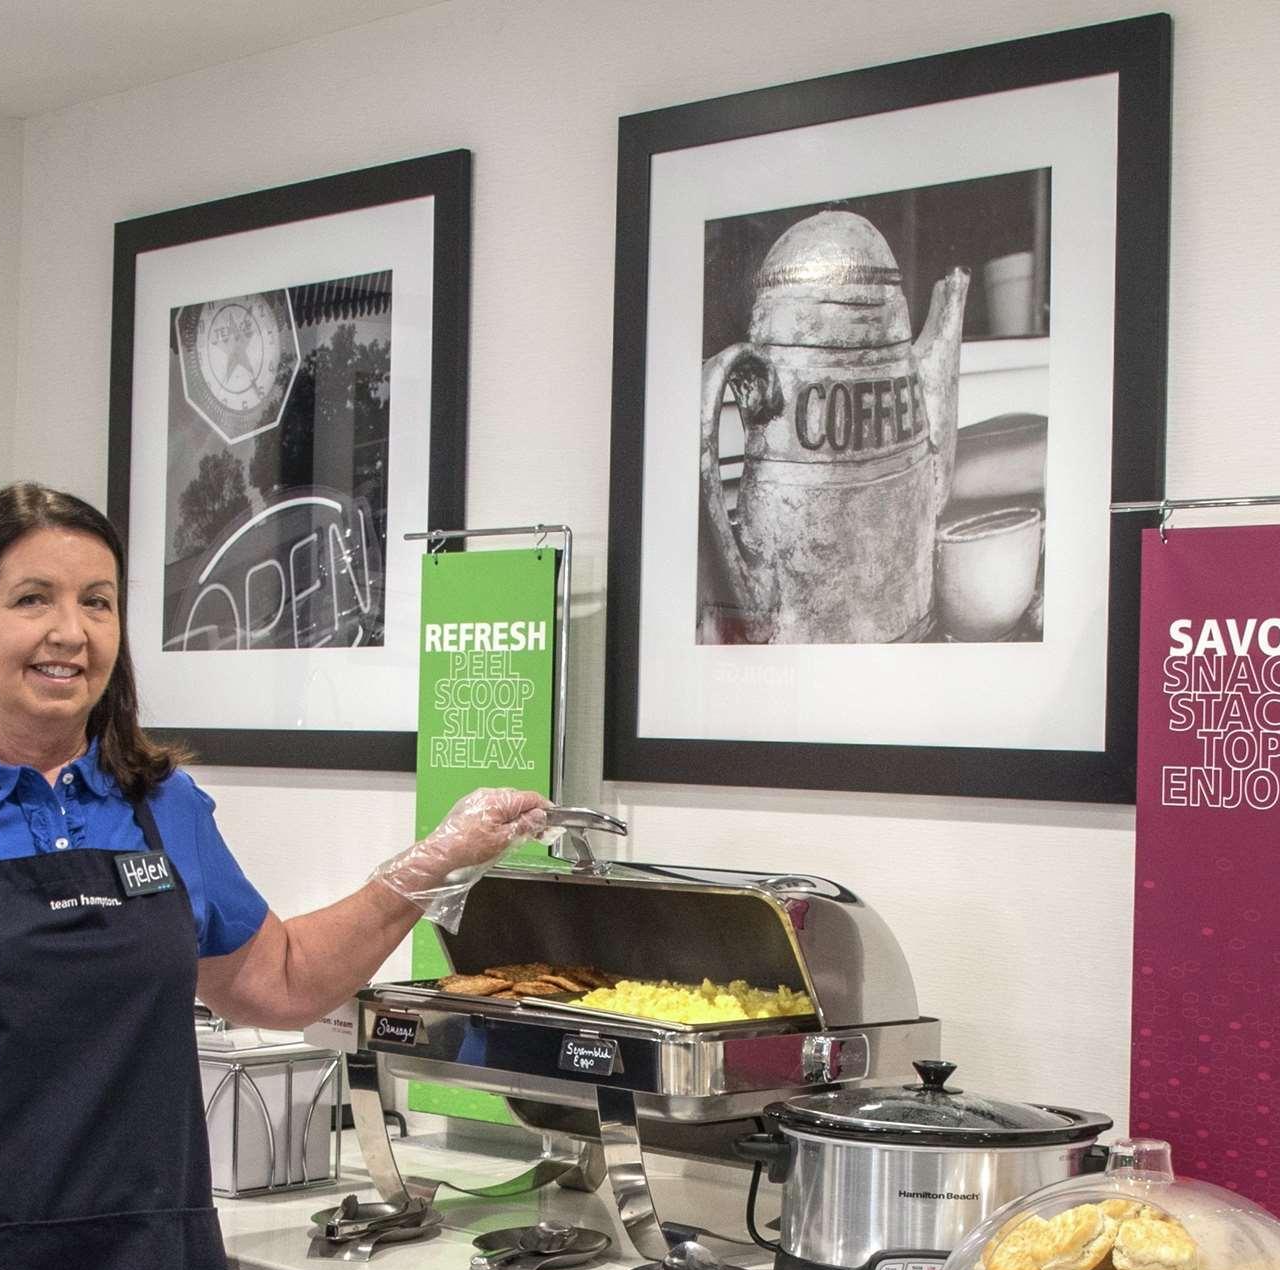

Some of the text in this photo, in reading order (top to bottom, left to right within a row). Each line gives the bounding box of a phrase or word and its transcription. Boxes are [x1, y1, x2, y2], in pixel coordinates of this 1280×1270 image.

[795, 374, 923, 451] COFFEE
[184, 508, 371, 650] OPEN
[425, 621, 547, 652] REFRESH
[450, 650, 520, 680] PEEL
[434, 678, 536, 711] SCOOP
[443, 708, 525, 740] SLICE
[430, 737, 535, 770] RELAX.
[50, 898, 78, 910] team
[898, 1189, 980, 1201] Hamilton Beach
